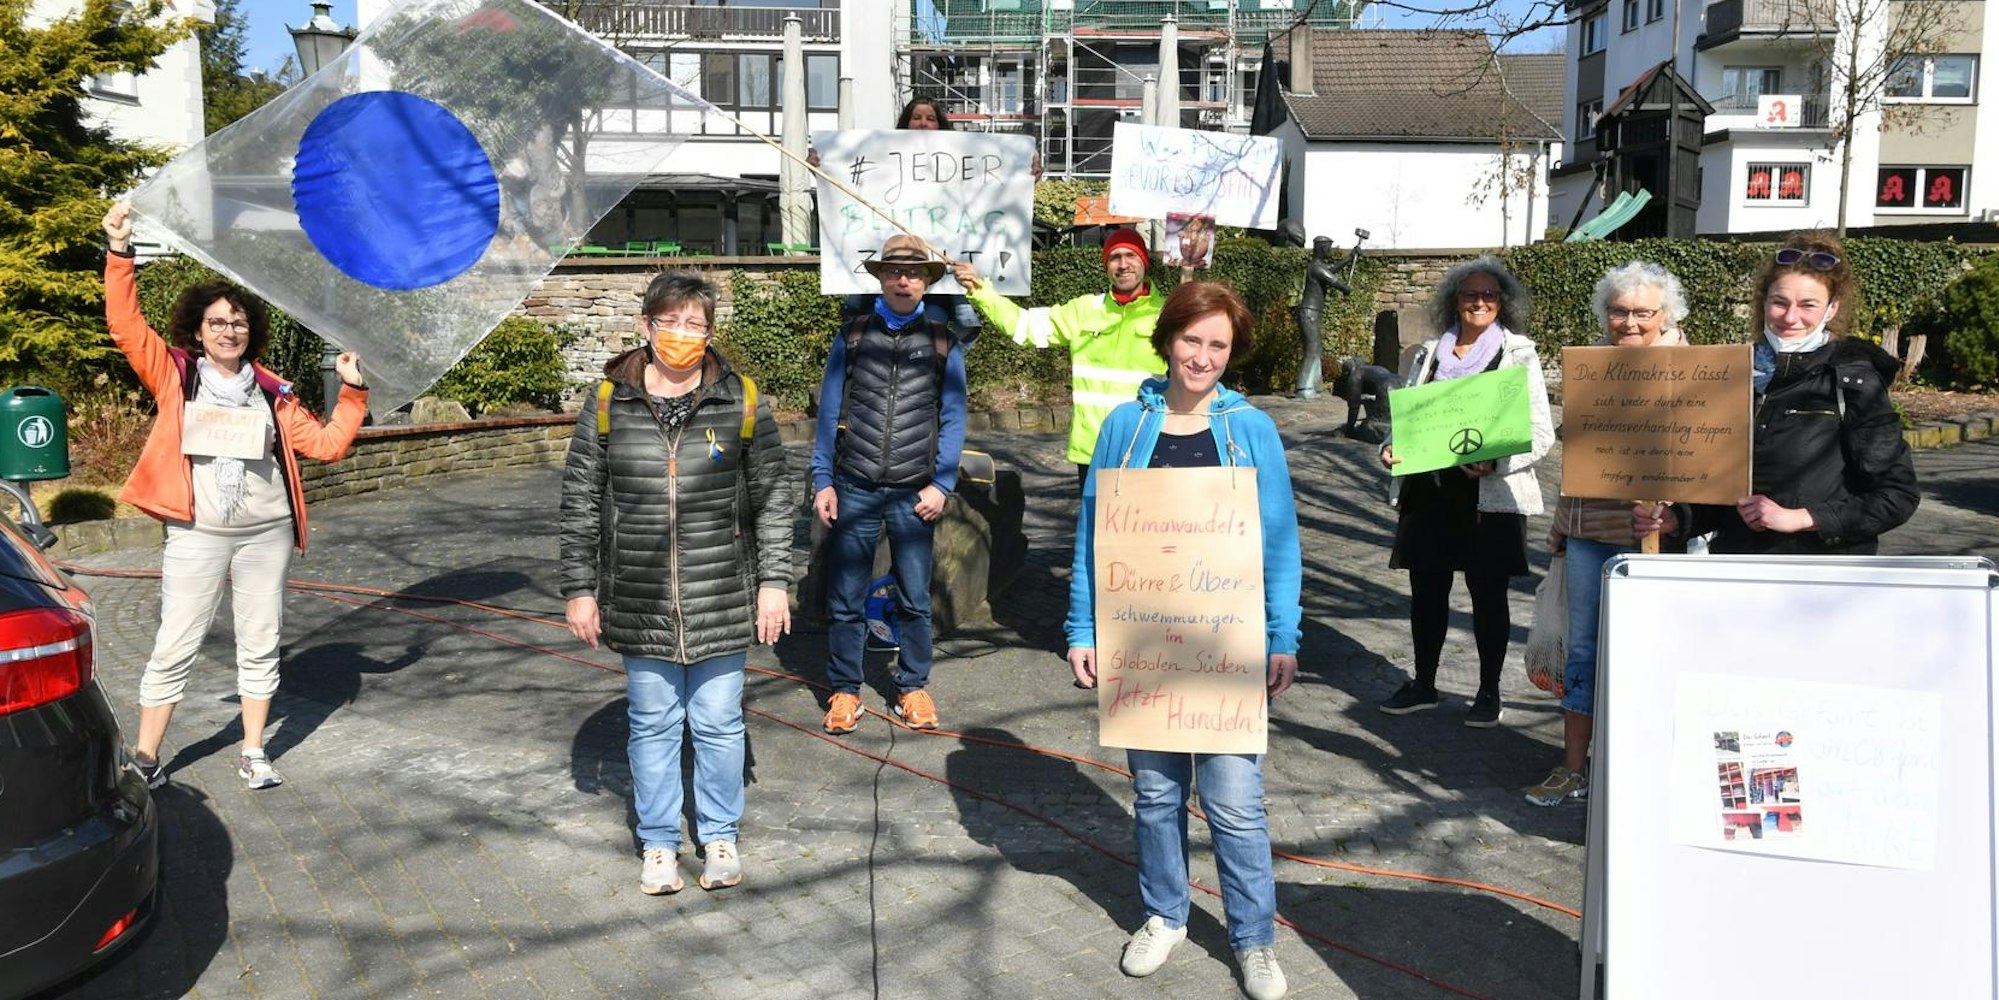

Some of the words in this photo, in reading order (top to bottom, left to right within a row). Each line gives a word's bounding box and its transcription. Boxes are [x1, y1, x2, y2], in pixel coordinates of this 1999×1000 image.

[1573, 363, 1598, 381] Die
[1602, 362, 1687, 382] Klimakrise
[1692, 363, 1731, 381] lässt
[1592, 395, 1615, 407] sich
[1621, 395, 1649, 408] weder
[1653, 395, 1683, 408] durch
[1686, 398, 1707, 408] eine
[1580, 414, 1692, 444] Friedensverhandlung
[1693, 421, 1732, 444] stoppen
[1112, 605, 1244, 632] schwemmungen
[1165, 628, 1184, 644] im
[1111, 651, 1182, 671] Globalen
[1189, 650, 1249, 674] Süden
[1106, 676, 1168, 718] Jetzt
